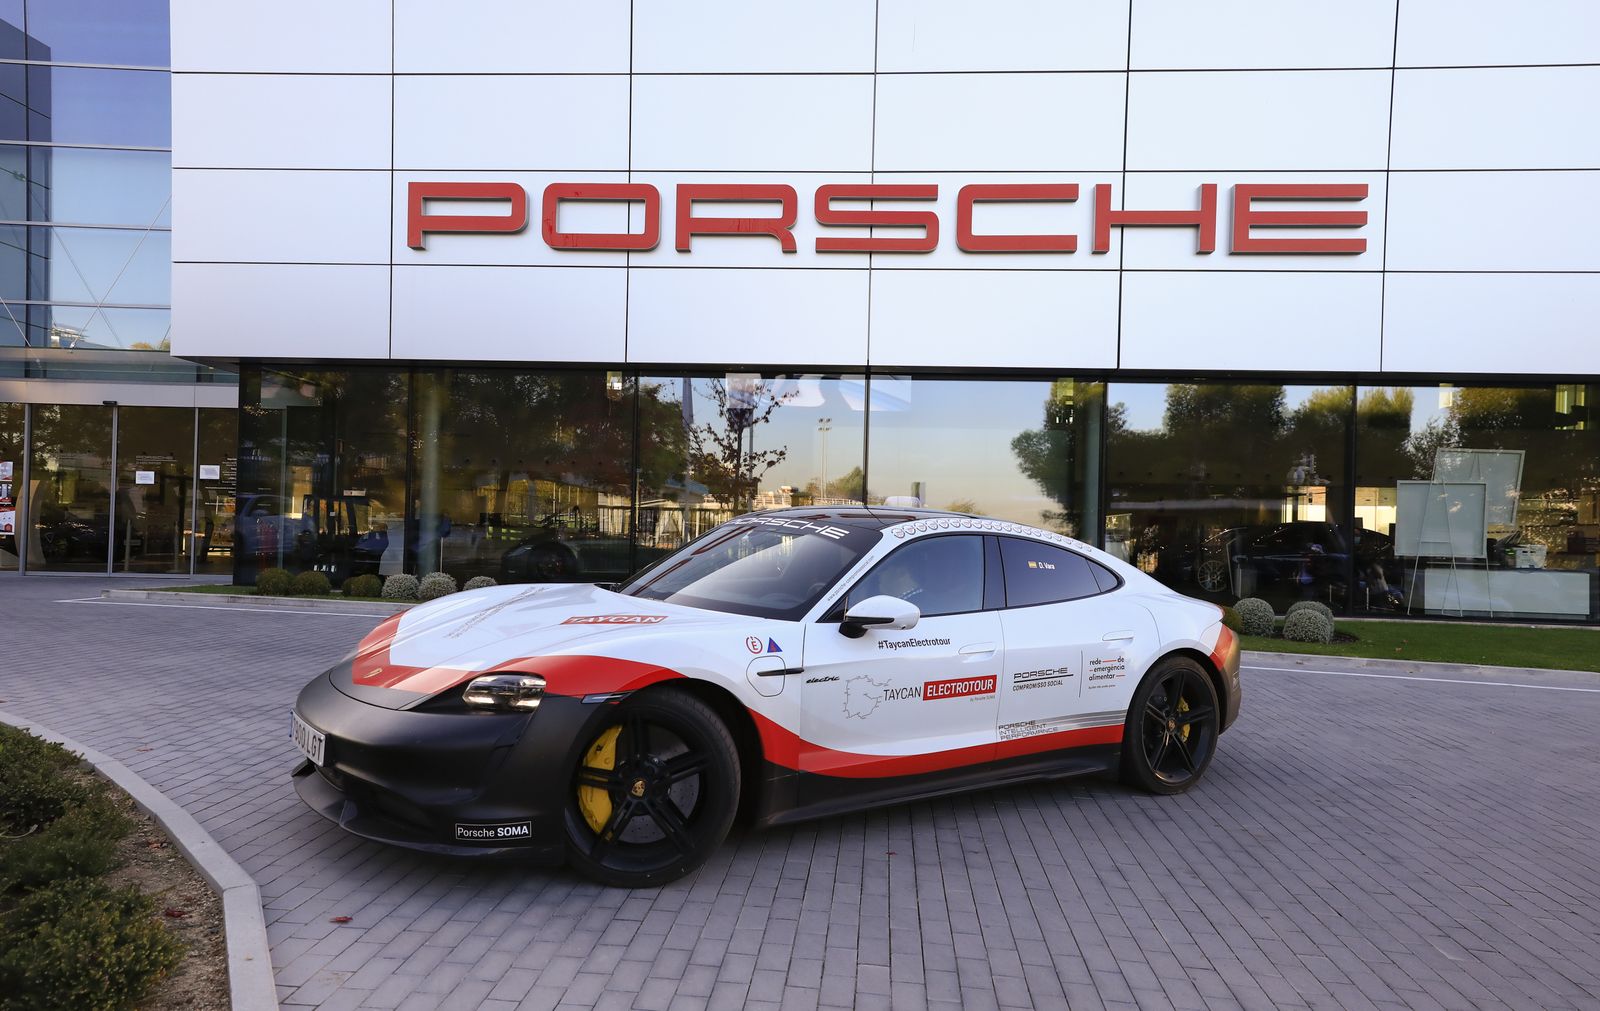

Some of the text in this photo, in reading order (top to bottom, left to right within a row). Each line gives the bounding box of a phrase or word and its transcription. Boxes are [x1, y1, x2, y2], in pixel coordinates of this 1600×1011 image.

[408, 182, 1368, 256] PORSCHE
[878, 638, 951, 651] #TaycanElectrotour
[1089, 658, 1102, 666] rede
[1013, 667, 1068, 680] PORSCHE
[1088, 673, 1116, 682] alimentar
[806, 676, 840, 684] electric
[1012, 680, 1063, 692] COMPROMISSO SOCIAL
[883, 679, 994, 701] TAYCAN ELECTROTOUR
[998, 720, 1036, 730] PORSCHE
[999, 723, 1047, 736] INTELLIGENT
[307, 730, 322, 761] LGT
[457, 825, 529, 837] Porsche SOMA
